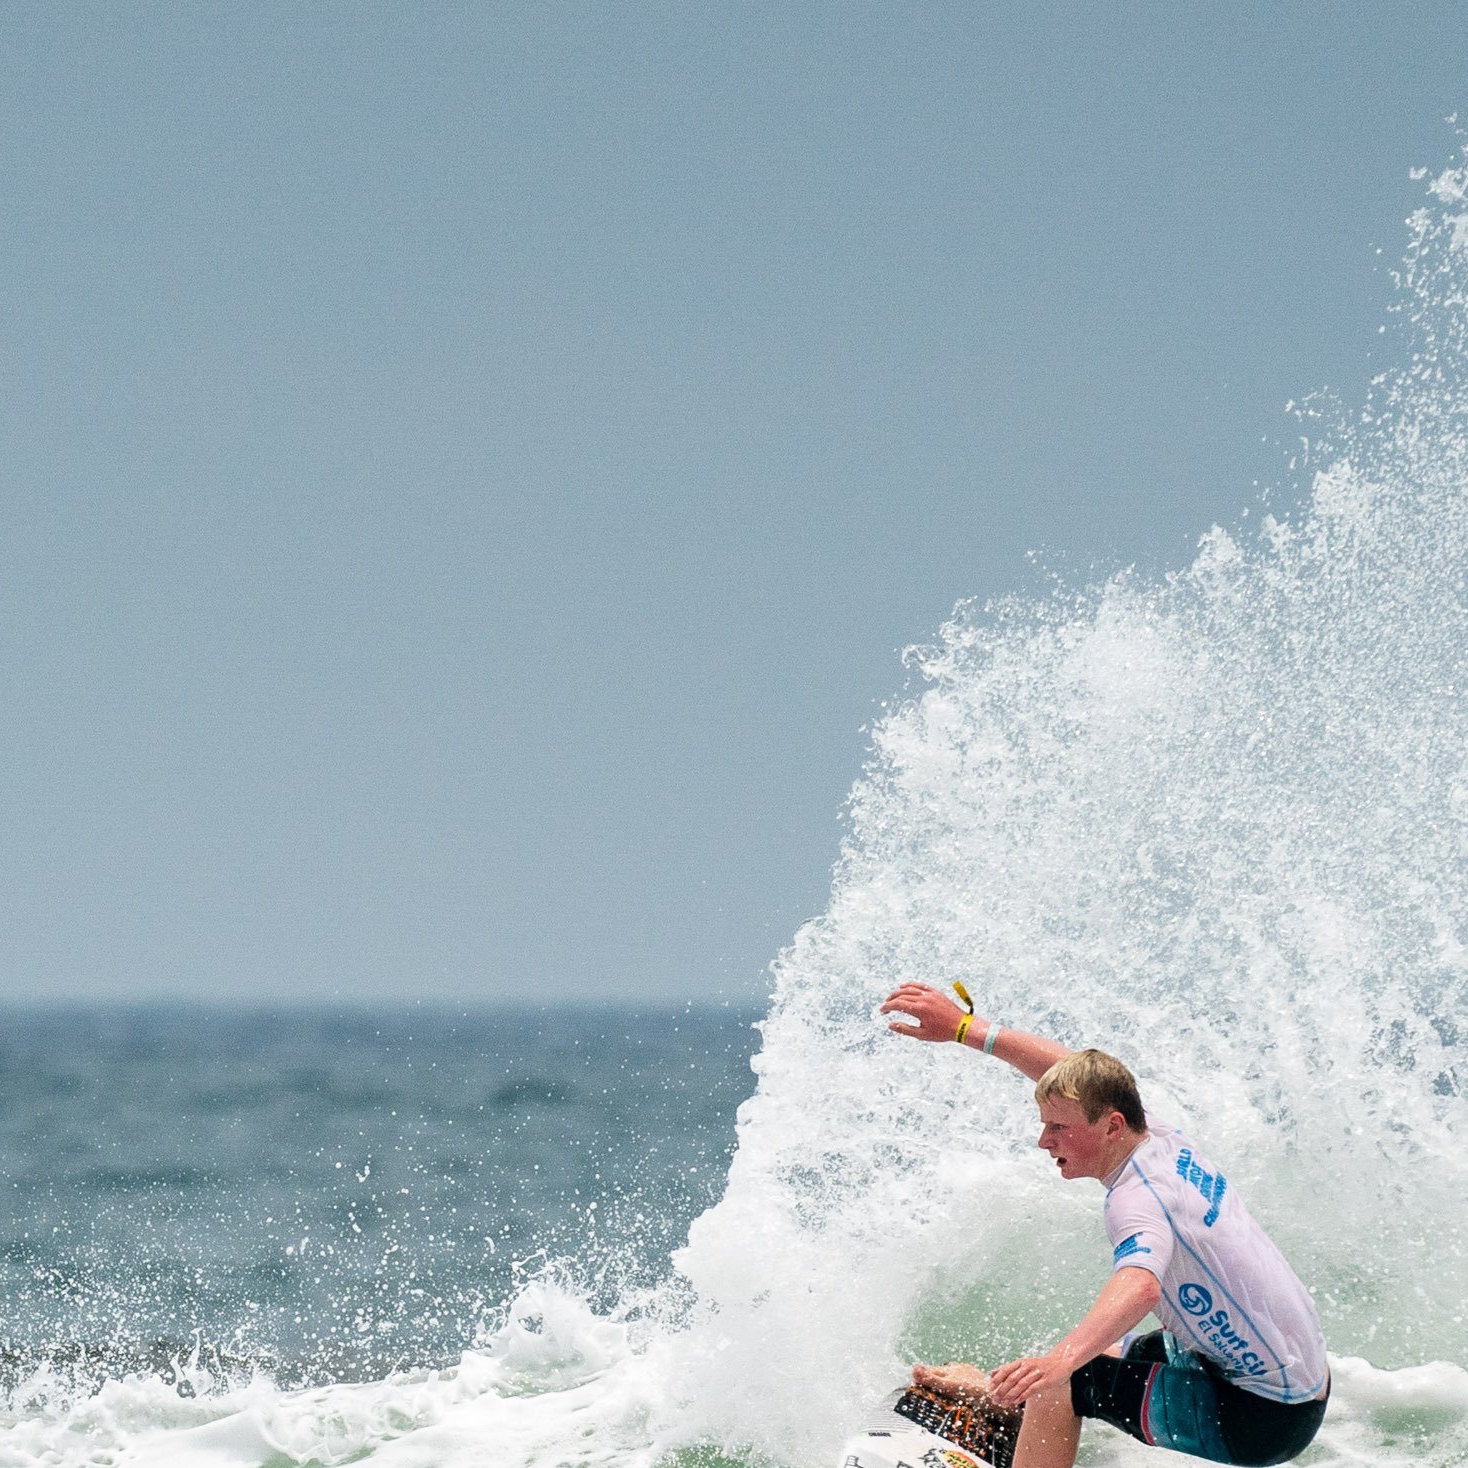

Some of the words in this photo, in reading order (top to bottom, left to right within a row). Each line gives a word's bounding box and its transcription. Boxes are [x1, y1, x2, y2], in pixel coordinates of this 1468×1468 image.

[1197, 1320, 1213, 1334] El
[1209, 1310, 1249, 1351] Surf
[1241, 1351, 1268, 1376] Ci
